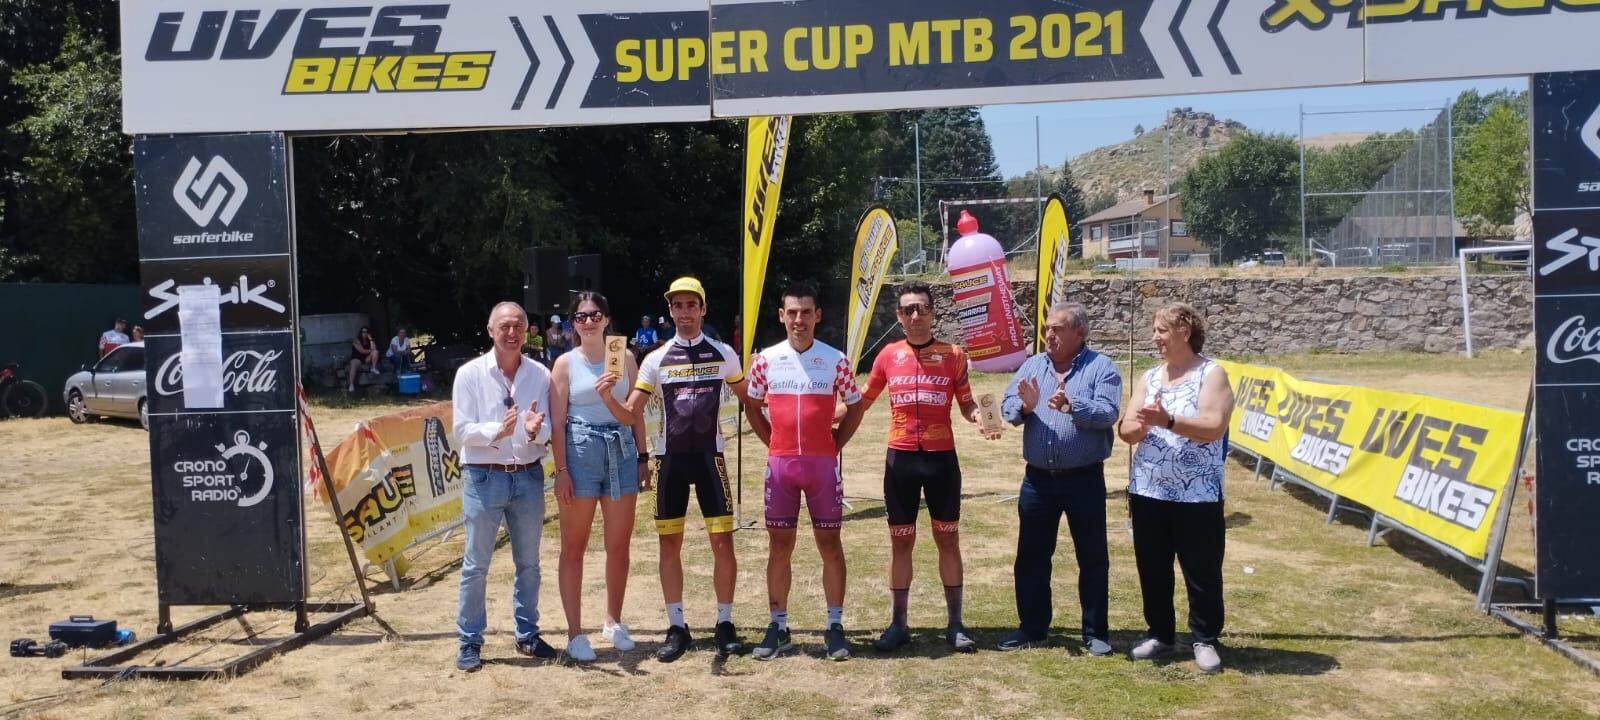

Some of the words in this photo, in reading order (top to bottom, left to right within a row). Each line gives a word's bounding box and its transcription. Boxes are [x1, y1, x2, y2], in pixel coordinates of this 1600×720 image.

[145, 3, 451, 62] UVES
[615, 29, 769, 83] SUPER
[783, 24, 873, 71] CUP
[889, 17, 994, 66] MTB
[1009, 10, 1124, 61] 2021
[282, 51, 496, 95] BIKES
[173, 231, 254, 244] sanferbike
[889, 374, 950, 386] SPECIALIZED
[1290, 433, 1353, 476] BIKES
[1359, 408, 1489, 480] UVES
[174, 461, 226, 472] CRONO
[183, 475, 235, 487] SPORT
[192, 489, 238, 501] RADIO
[1395, 464, 1496, 531] BIKES
